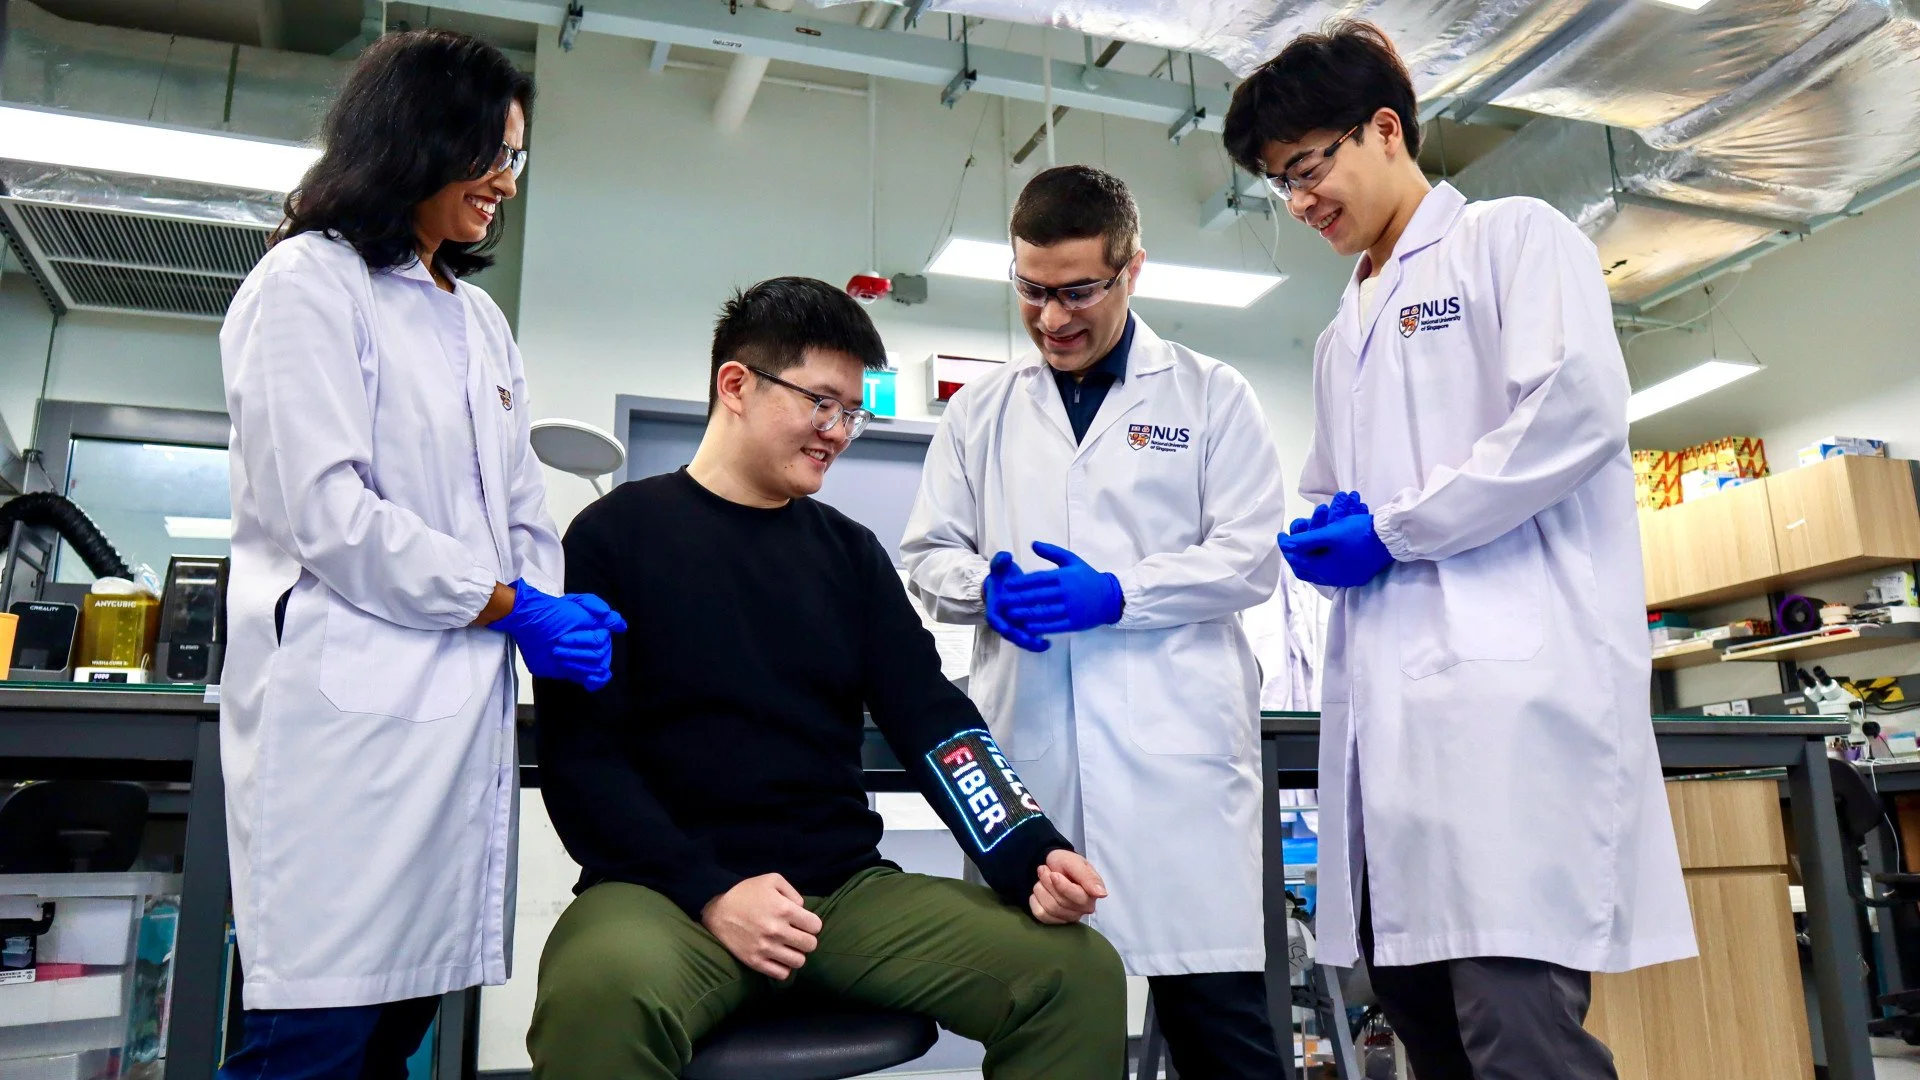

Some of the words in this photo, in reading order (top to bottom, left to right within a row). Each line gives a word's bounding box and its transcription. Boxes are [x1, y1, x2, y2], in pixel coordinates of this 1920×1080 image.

[1422, 296, 1460, 318] NUS
[1438, 315, 1461, 324] University
[1152, 426, 1190, 442] NUS
[94, 600, 137, 608] ANYCUBIC
[942, 745, 1007, 834] FIBER
